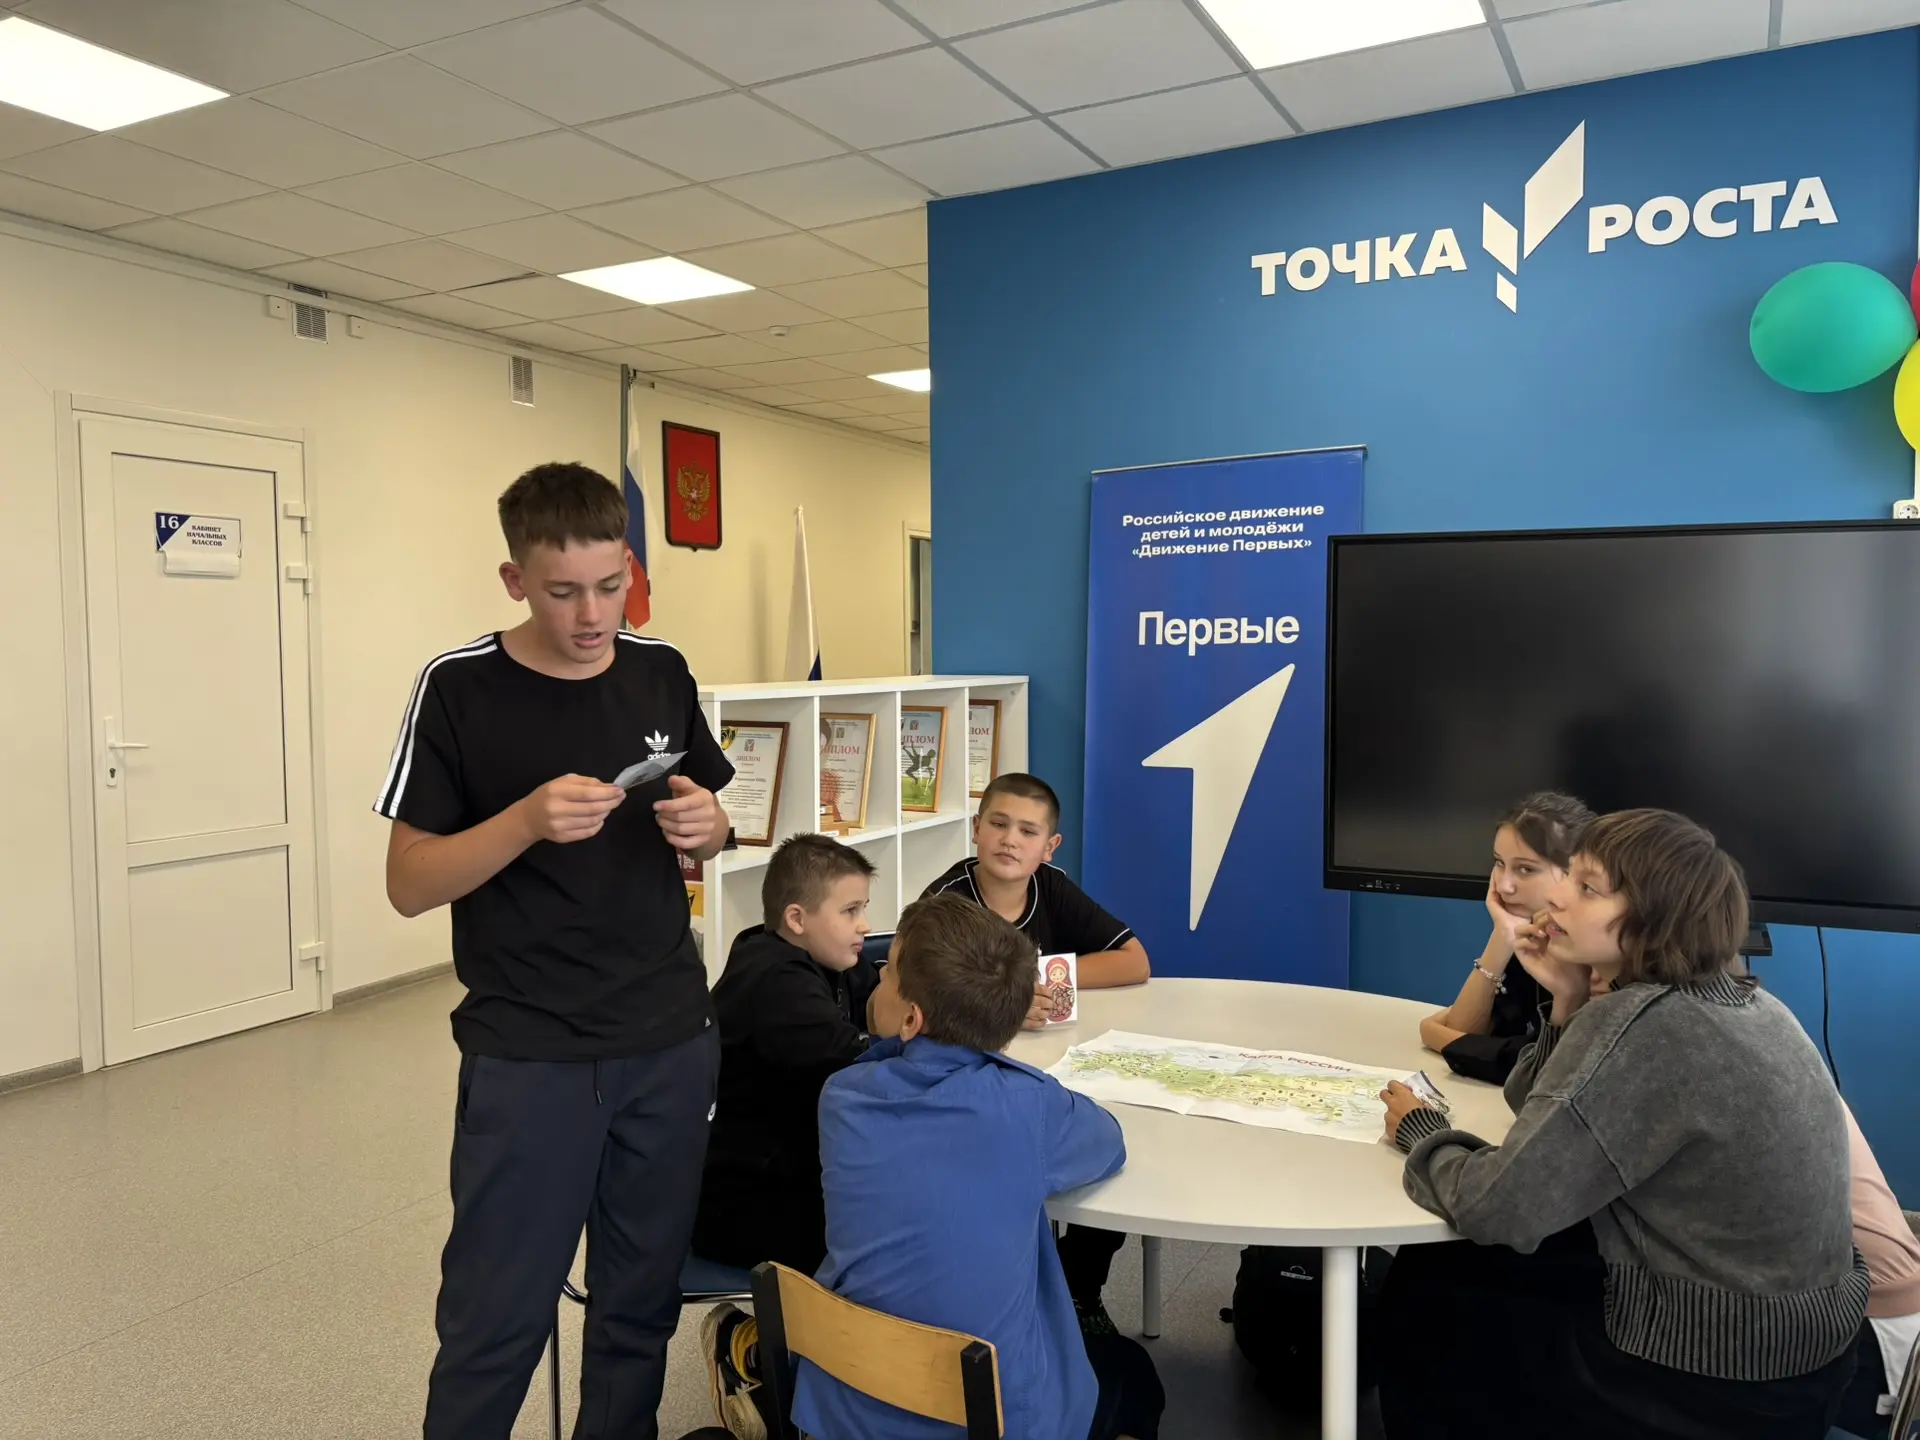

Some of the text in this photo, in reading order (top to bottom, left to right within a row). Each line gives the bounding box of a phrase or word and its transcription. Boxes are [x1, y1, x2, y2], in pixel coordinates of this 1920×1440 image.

[1251, 176, 1839, 296] ТОЧКА РОСТА
[160, 515, 180, 530] 16
[1122, 505, 1325, 527] Российское движение
[186, 532, 227, 540] НАЧАЛЬНЫХ
[1140, 521, 1304, 543] детей и молодёжи
[1132, 539, 1312, 558] «Движение Первых»
[1138, 610, 1300, 657] Первые
[1238, 1052, 1352, 1072] КАРТА РОССИИ
